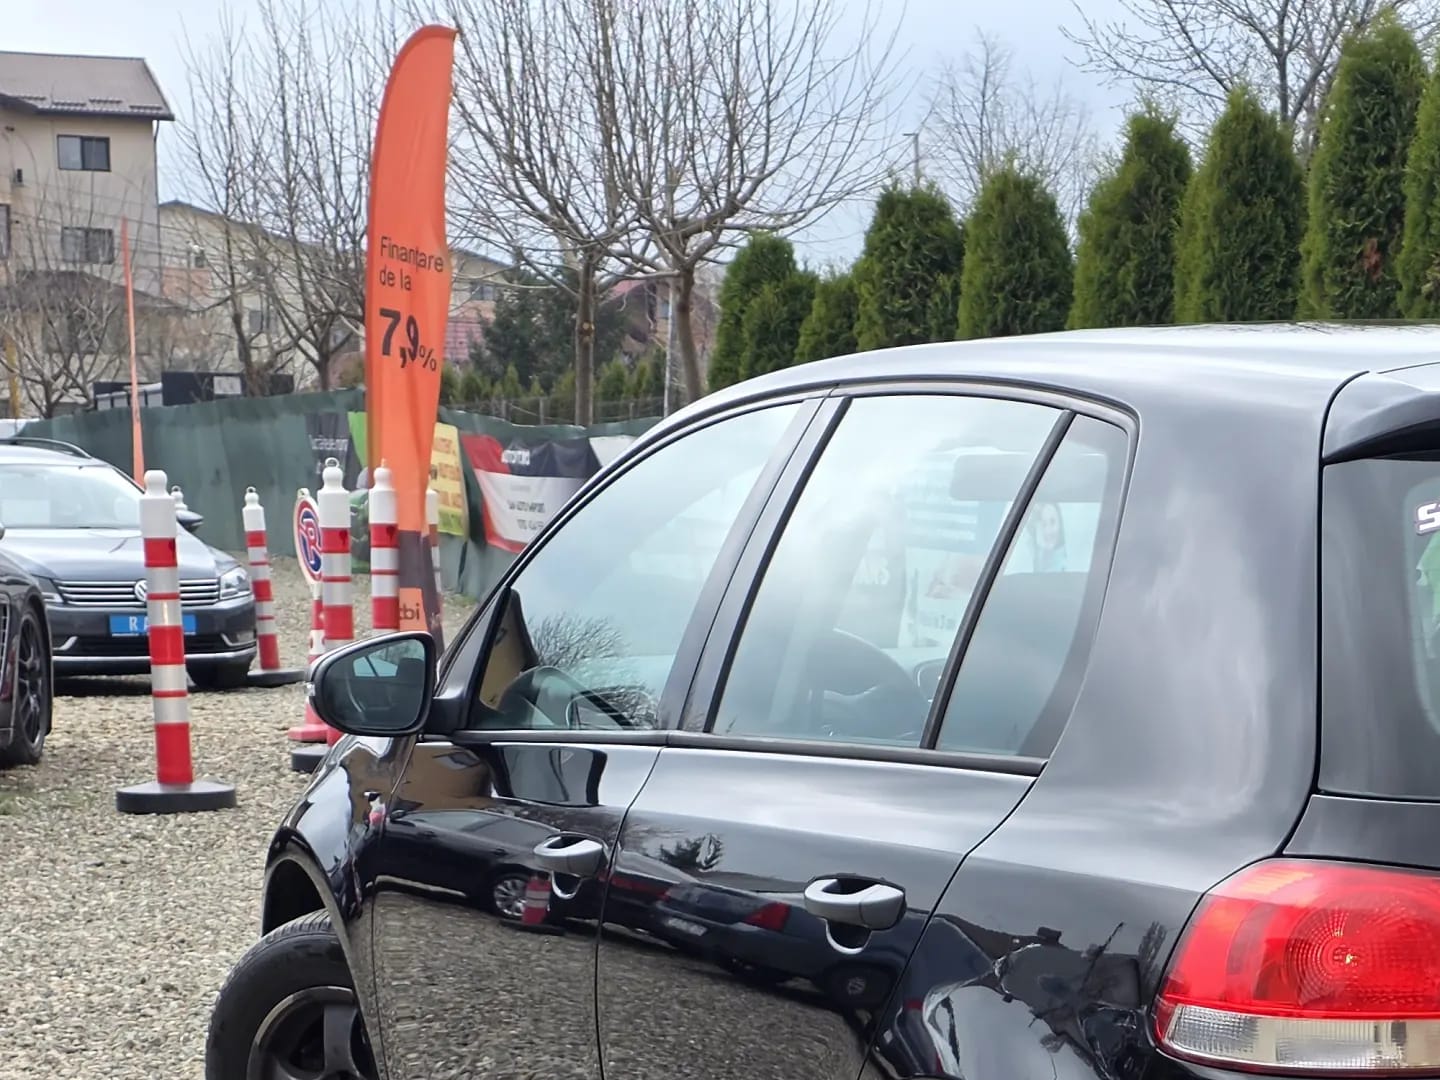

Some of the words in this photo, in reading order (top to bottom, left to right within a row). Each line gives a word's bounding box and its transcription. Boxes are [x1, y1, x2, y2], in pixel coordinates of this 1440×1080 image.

[380, 235, 444, 272] Finanțare
[379, 265, 395, 287] de
[400, 269, 412, 291] la
